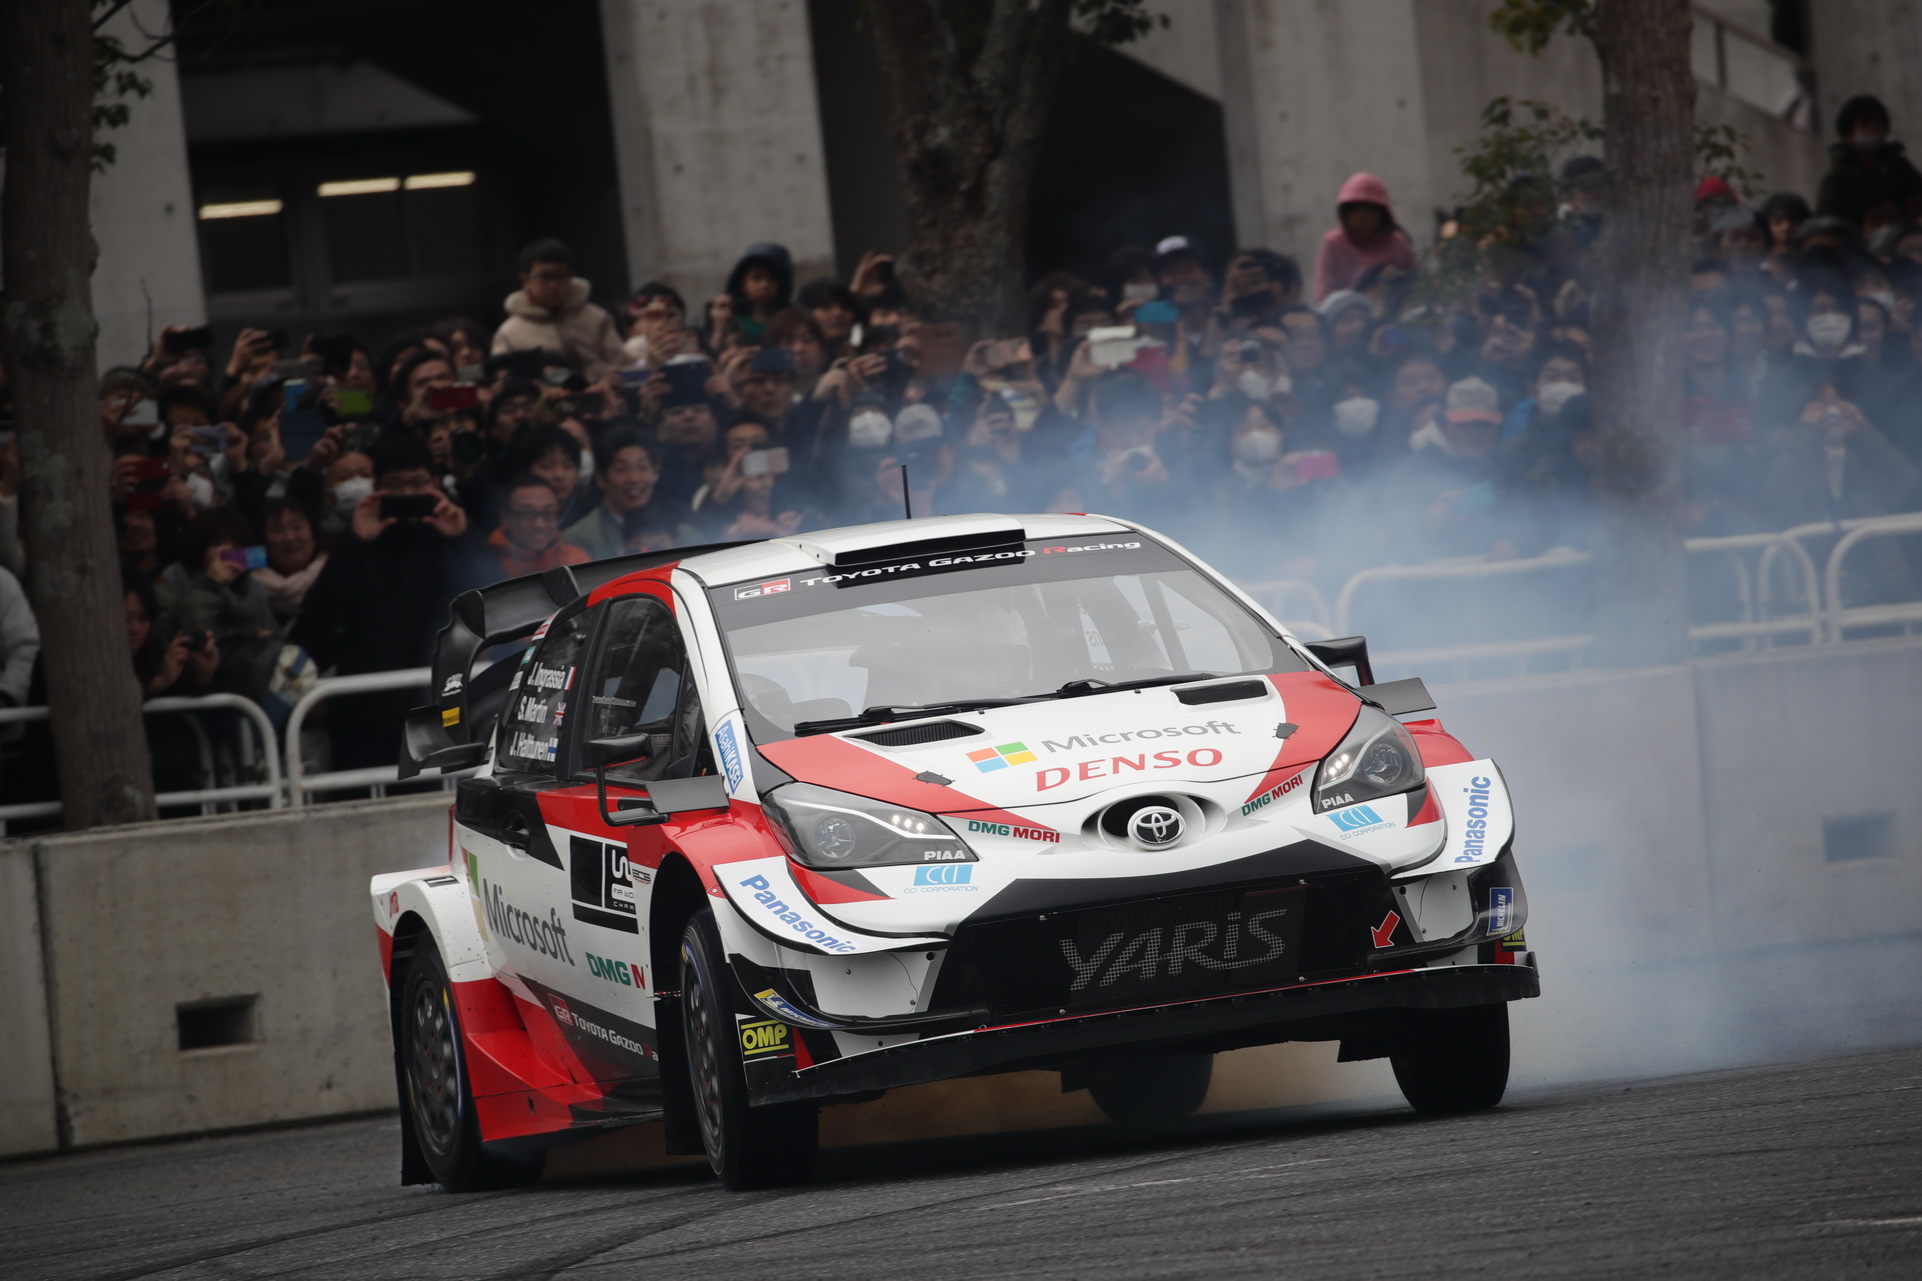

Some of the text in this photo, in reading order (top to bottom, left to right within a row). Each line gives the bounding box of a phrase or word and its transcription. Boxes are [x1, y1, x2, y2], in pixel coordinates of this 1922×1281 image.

[737, 541, 1142, 599] GR TOYOTA GAZOO Racing
[1041, 720, 1242, 753] Microsoft
[1034, 748, 1223, 792] DENSO
[1241, 774, 1304, 817] DMG MORI
[1321, 793, 1355, 809] PIAA
[968, 820, 1060, 843] DMG MORI
[1338, 807, 1372, 827] CCI
[1340, 821, 1396, 841] CCI CORPORATION
[1454, 776, 1491, 863] Panasonic
[924, 850, 966, 861] PIAA
[926, 866, 959, 884] CCI
[483, 878, 575, 967] Microsoft
[739, 874, 857, 953] Panasonic
[1496, 893, 1506, 928] MICHELIN
[585, 952, 632, 987] DMG
[554, 1004, 571, 1025] GR
[571, 1012, 609, 1040] TOYOTA
[608, 1029, 644, 1056] GAZOO
[742, 1024, 788, 1049] OMP
